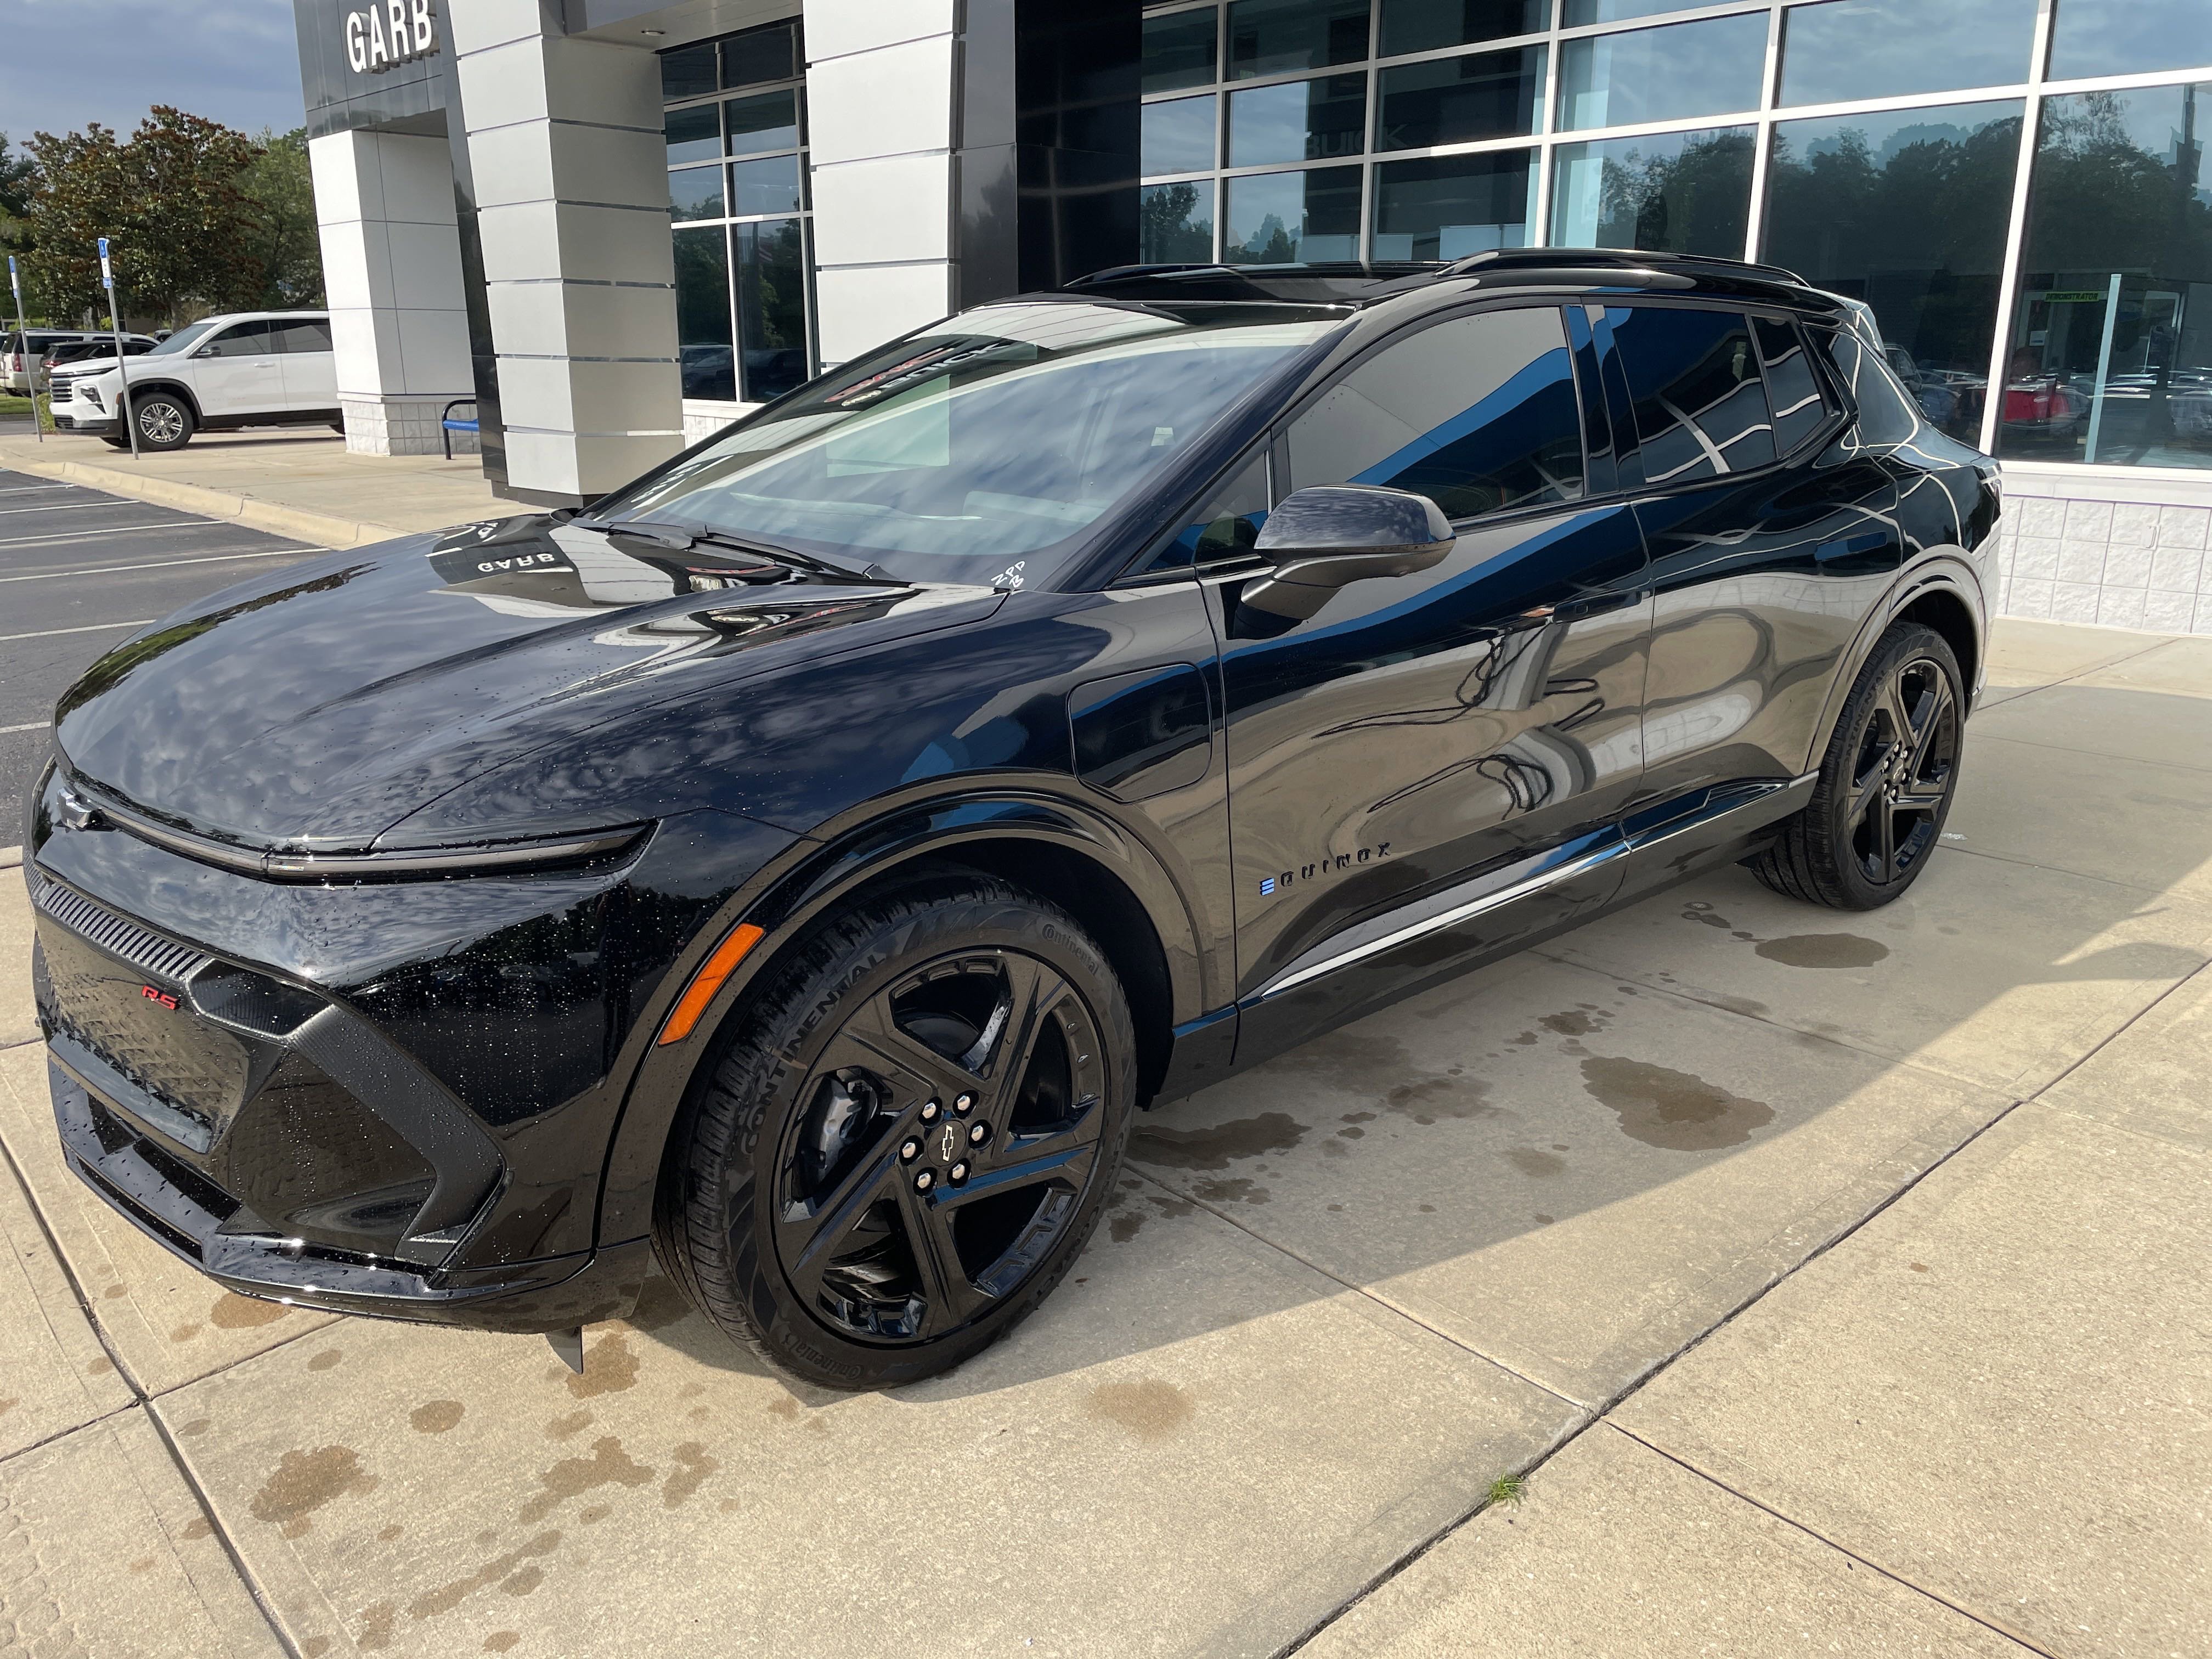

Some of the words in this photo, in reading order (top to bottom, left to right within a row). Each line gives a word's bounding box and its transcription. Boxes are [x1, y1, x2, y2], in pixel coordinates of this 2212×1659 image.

[2045, 292, 2098, 301] DEMONSTRATOR
[1260, 842, 1391, 896] EQUINOX
[1042, 923, 1099, 976] Continental
[142, 985, 179, 1010] RS
[741, 954, 885, 1155] CONTINENTAL
